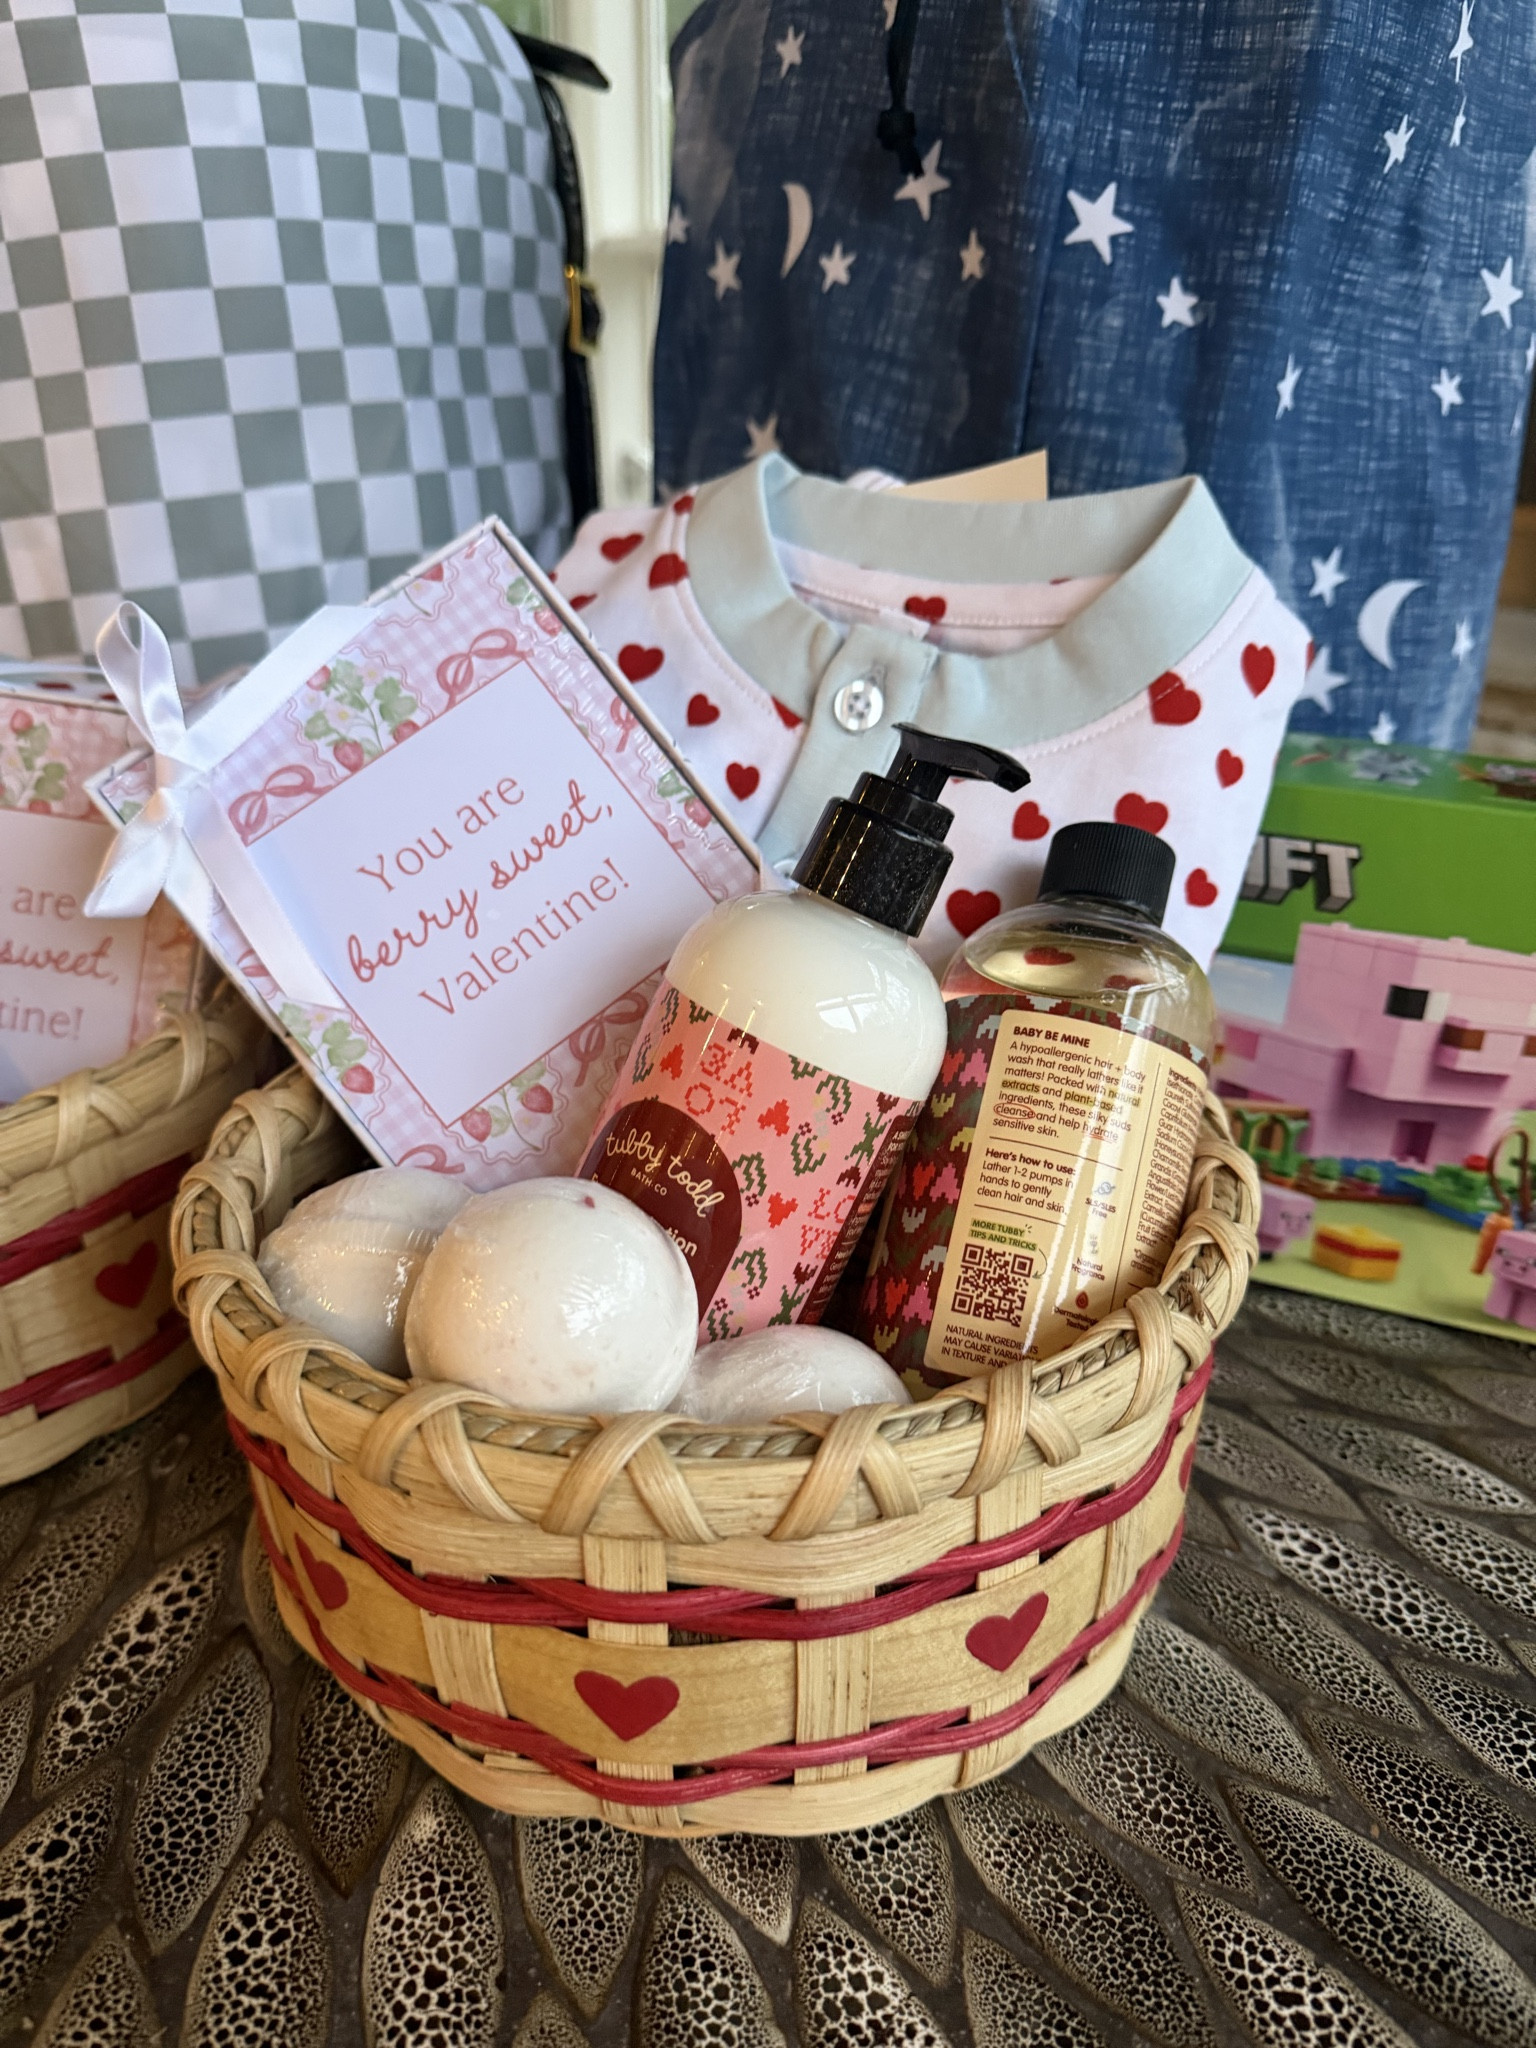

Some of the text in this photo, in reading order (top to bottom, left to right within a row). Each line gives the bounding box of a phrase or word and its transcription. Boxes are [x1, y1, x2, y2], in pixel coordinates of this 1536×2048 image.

[357, 777, 524, 892] You are
[348, 779, 613, 983] berry sweet,
[12, 886, 76, 921] are
[418, 857, 629, 1015] Valentine!
[0, 935, 119, 986] sweet,
[1013, 1026, 1090, 1048] BABY BE MINE
[1007, 1054, 1033, 1066] wash
[1036, 1058, 1056, 1070] that
[1058, 1062, 1086, 1077] really
[1087, 1069, 1120, 1086] lathers
[1010, 1041, 1018, 1050] A
[1020, 1041, 1093, 1065] hypoallergenic
[1094, 1055, 1113, 1070] hair
[1124, 1065, 1146, 1083] body
[1001, 1079, 1123, 1114] extracts and plant-based
[1004, 1067, 1141, 1107] matters! Packed with natural
[996, 1104, 1118, 1142] cleanse and help hydrate
[998, 1090, 1132, 1132] ingredients, these silky suds
[992, 1118, 1059, 1138] sensitive skin.
[606, 1128, 725, 1218] tubby todd
[982, 1160, 1074, 1188] Lather 1-2 pumps in
[985, 1148, 1076, 1176] Here's how to use:
[980, 1174, 1052, 1198] hands to gently
[976, 1186, 1068, 1216] clean hair and skin.
[970, 1230, 1037, 1250] TIPS AND TRICKS
[972, 1219, 1026, 1237] MORE TUBBY
[1072, 1264, 1106, 1282] Fragrance
[1076, 1257, 1104, 1272] Natural
[946, 1324, 983, 1341] NATURAL
[1066, 1318, 1089, 1332] Tested
[942, 1346, 1008, 1368] IN TEXTURE AND
[944, 1336, 964, 1347] MAY
[964, 1340, 992, 1354] CAUSE
